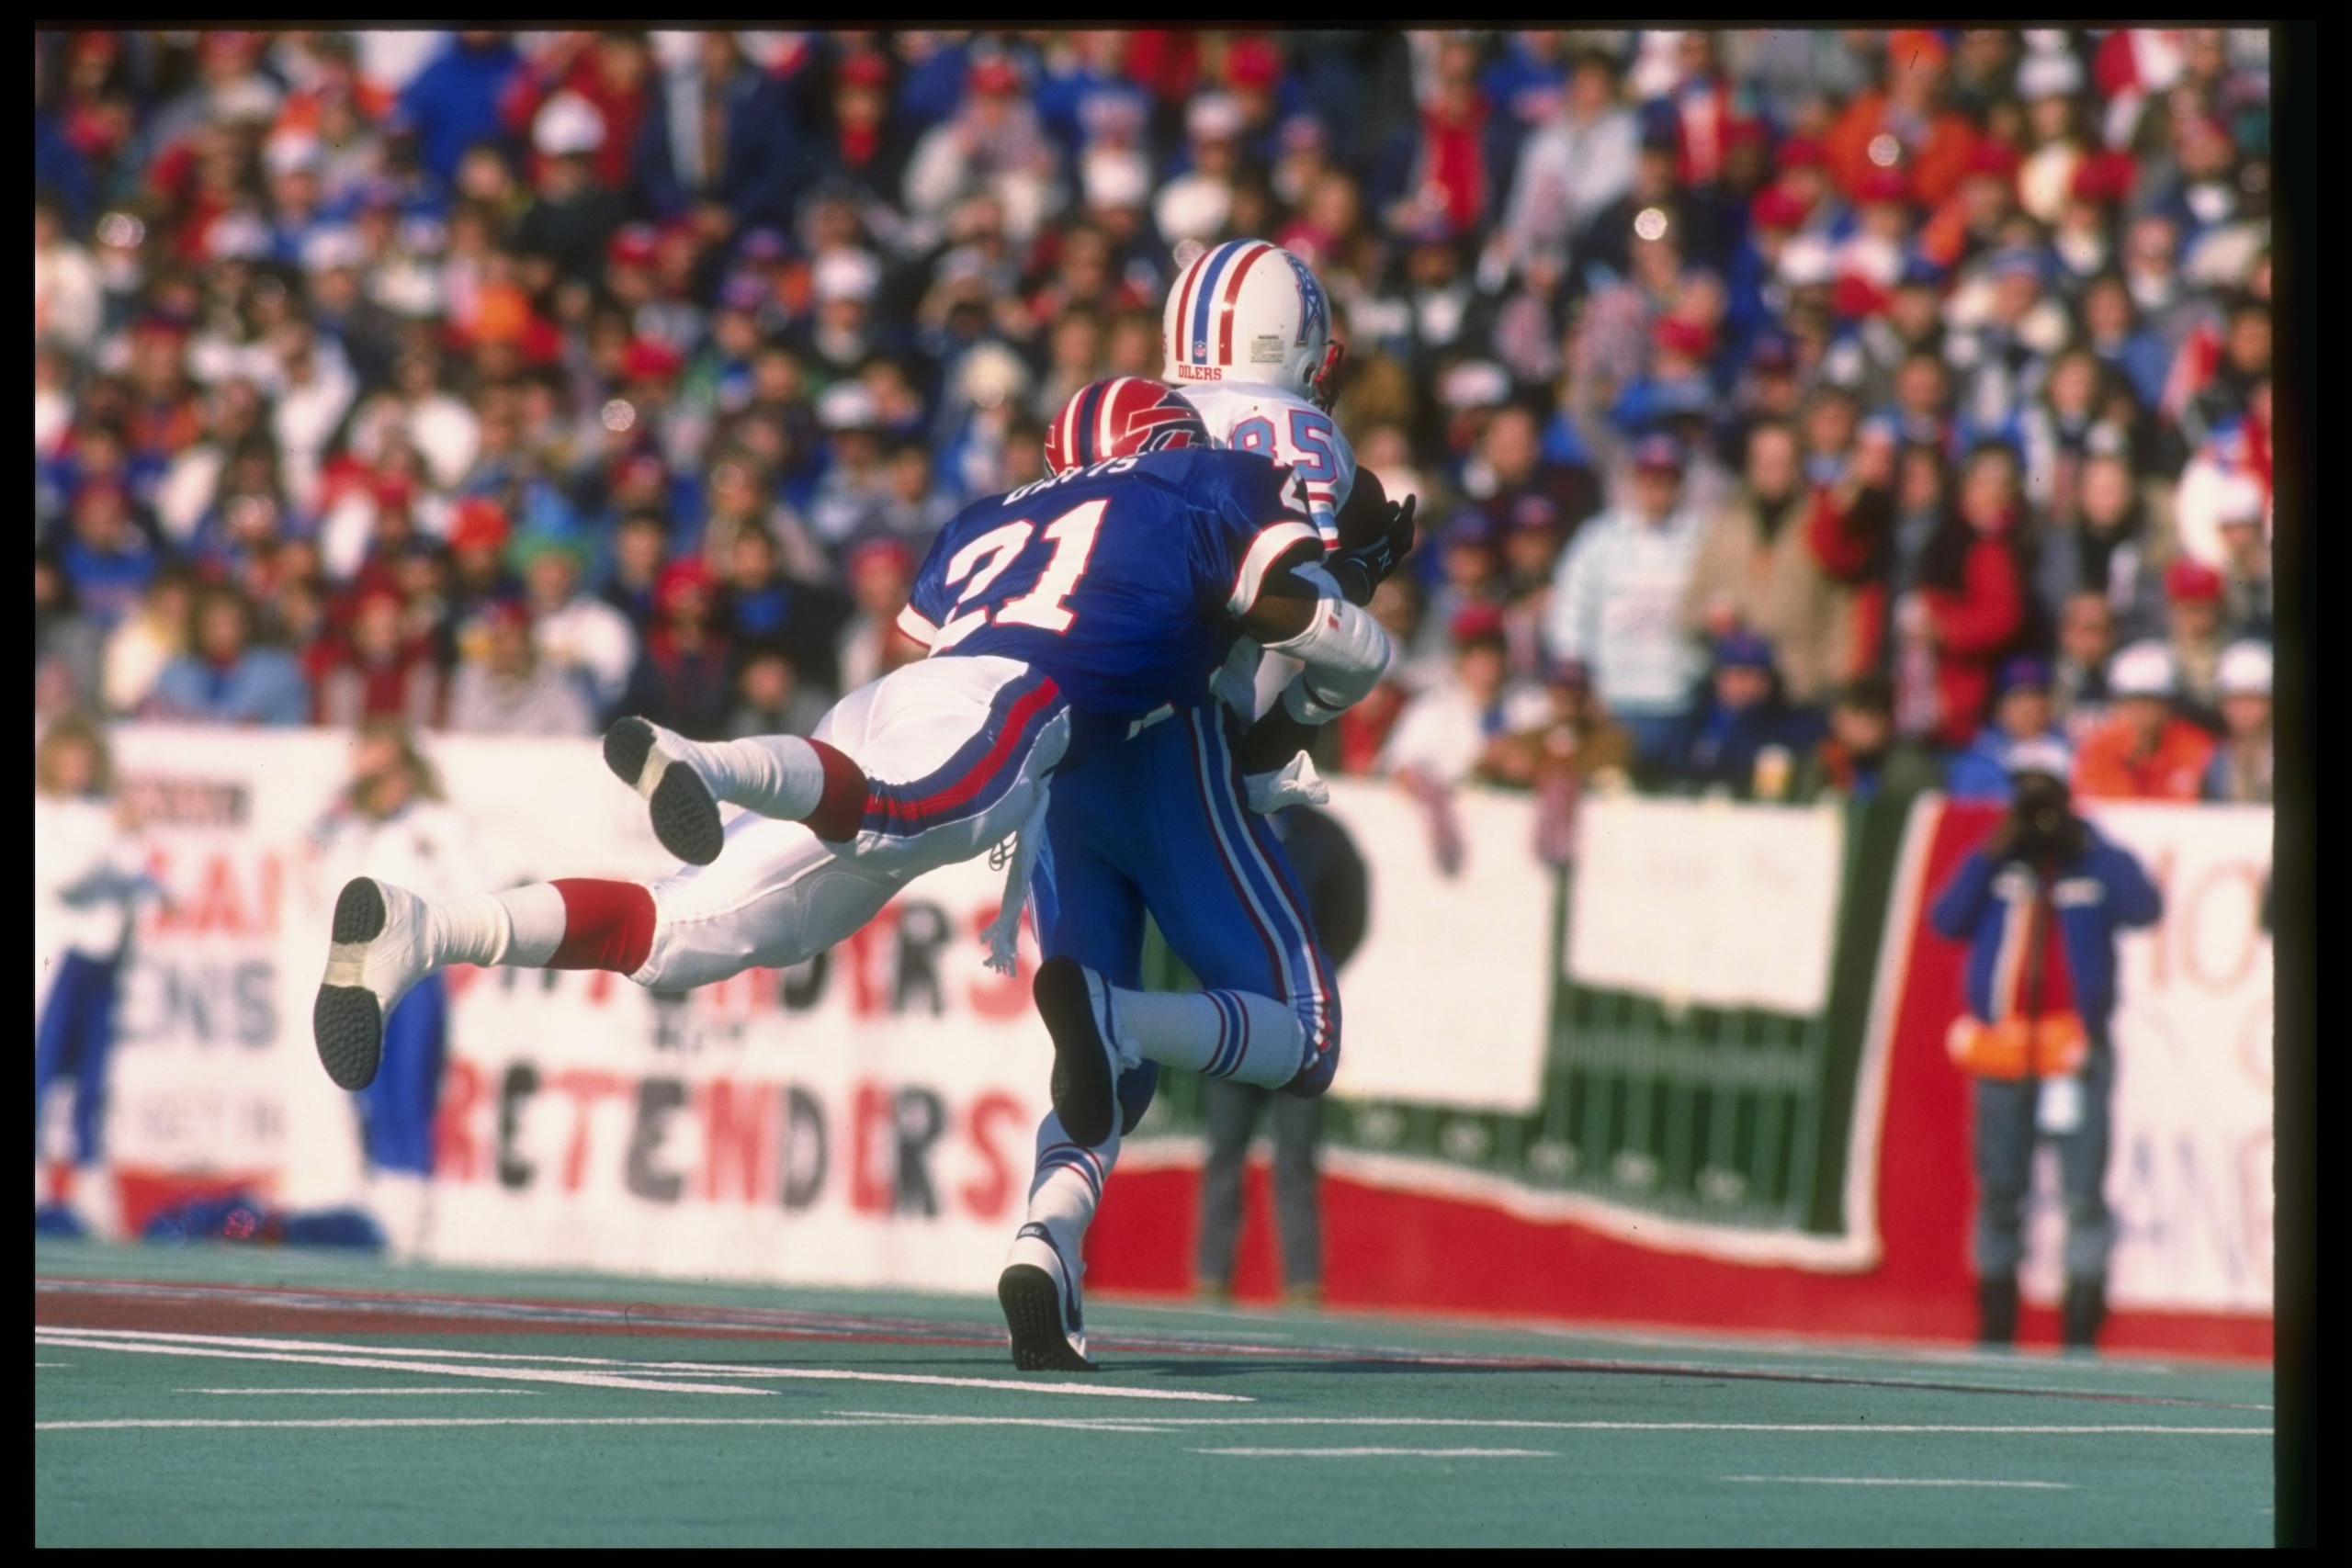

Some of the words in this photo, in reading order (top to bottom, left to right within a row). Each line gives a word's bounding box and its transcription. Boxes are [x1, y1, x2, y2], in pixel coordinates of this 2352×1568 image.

[1179, 365, 1222, 380] OILERS
[928, 497, 1112, 658] 21
[430, 1058, 1027, 1222] RETENDERS
